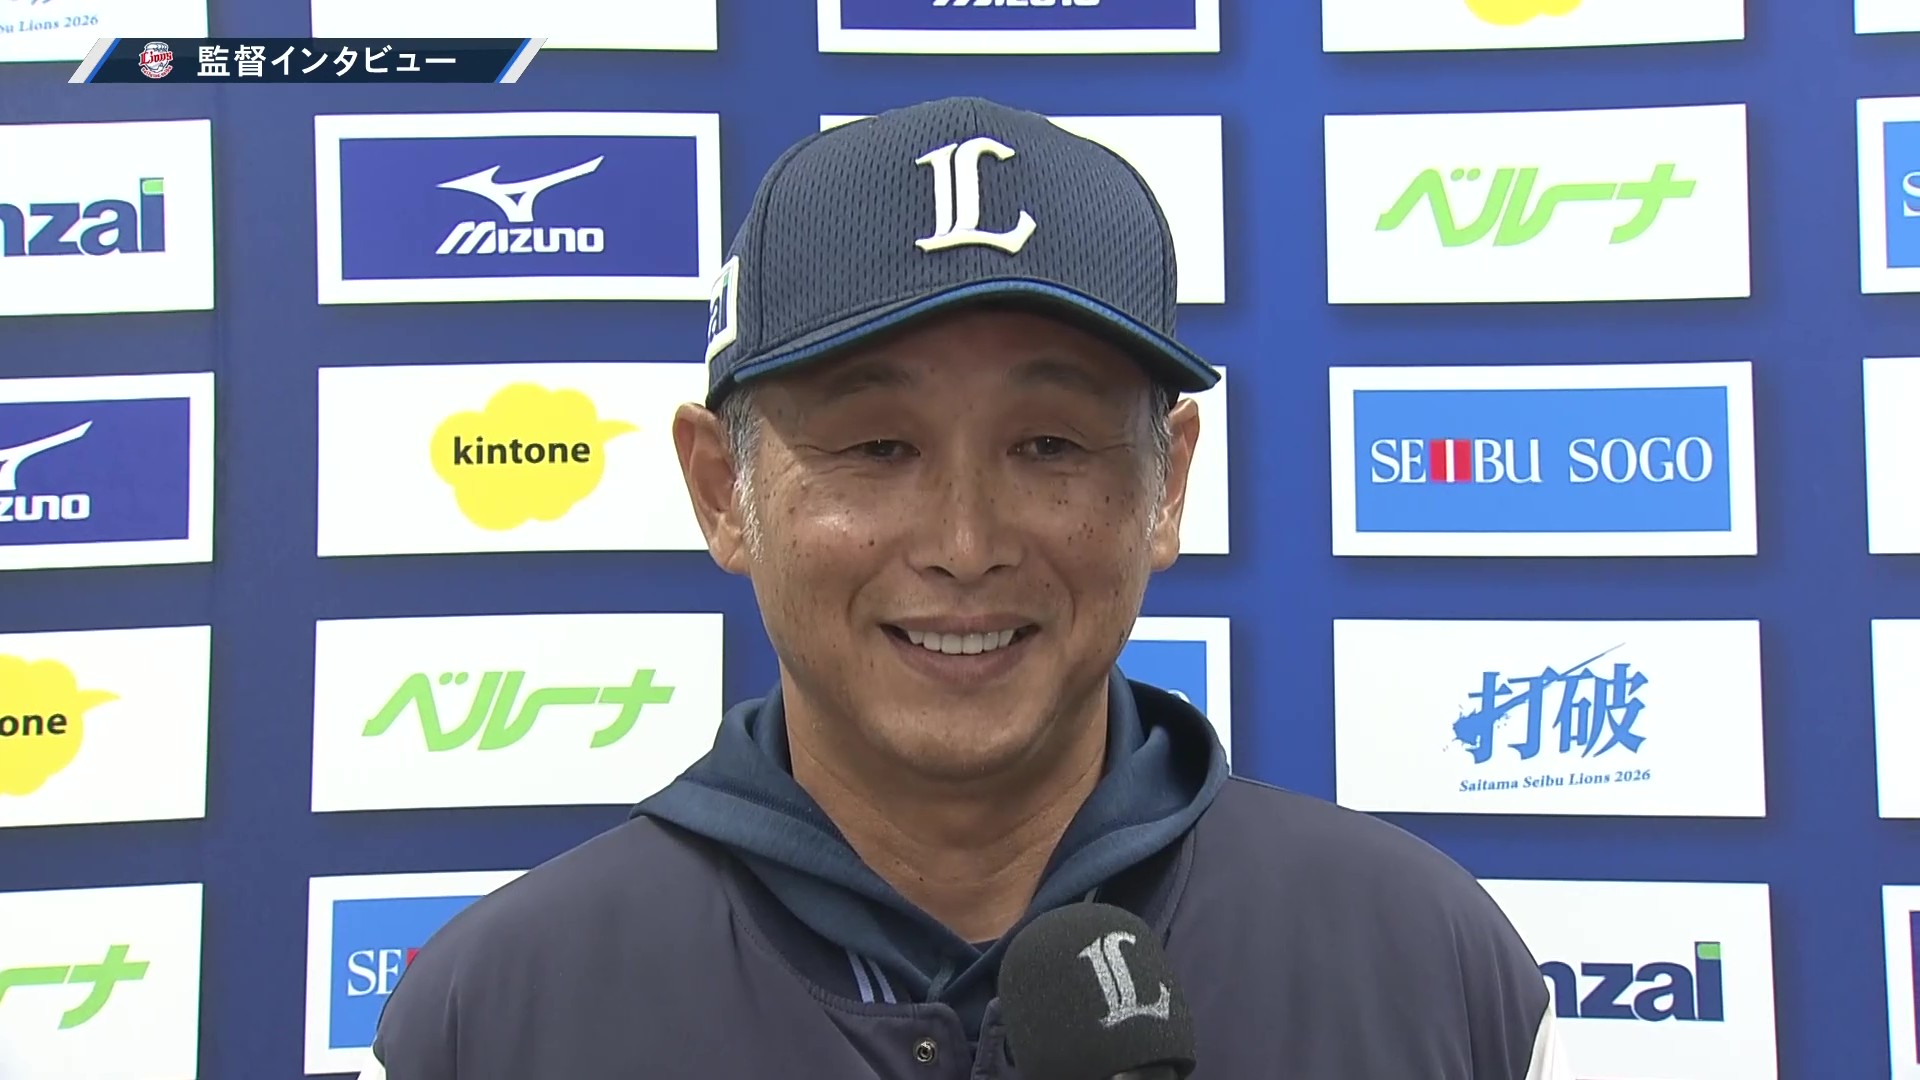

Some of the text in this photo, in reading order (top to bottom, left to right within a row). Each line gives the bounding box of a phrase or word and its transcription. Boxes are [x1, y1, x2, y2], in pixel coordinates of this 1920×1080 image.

[19, 19, 60, 33] Lions
[63, 14, 99, 28] 2026
[914, 136, 1037, 255] L
[1375, 163, 1697, 247] ベルーナ
[435, 221, 604, 255] MIZUNO
[453, 436, 591, 465] kintone
[1371, 436, 1713, 484] SEIBU SOGO
[362, 669, 675, 752] ベルーナ
[1453, 660, 1649, 764] 打破
[1459, 768, 1652, 792] Saitama Seibu Lions 2026
[1078, 930, 1171, 1028] L
